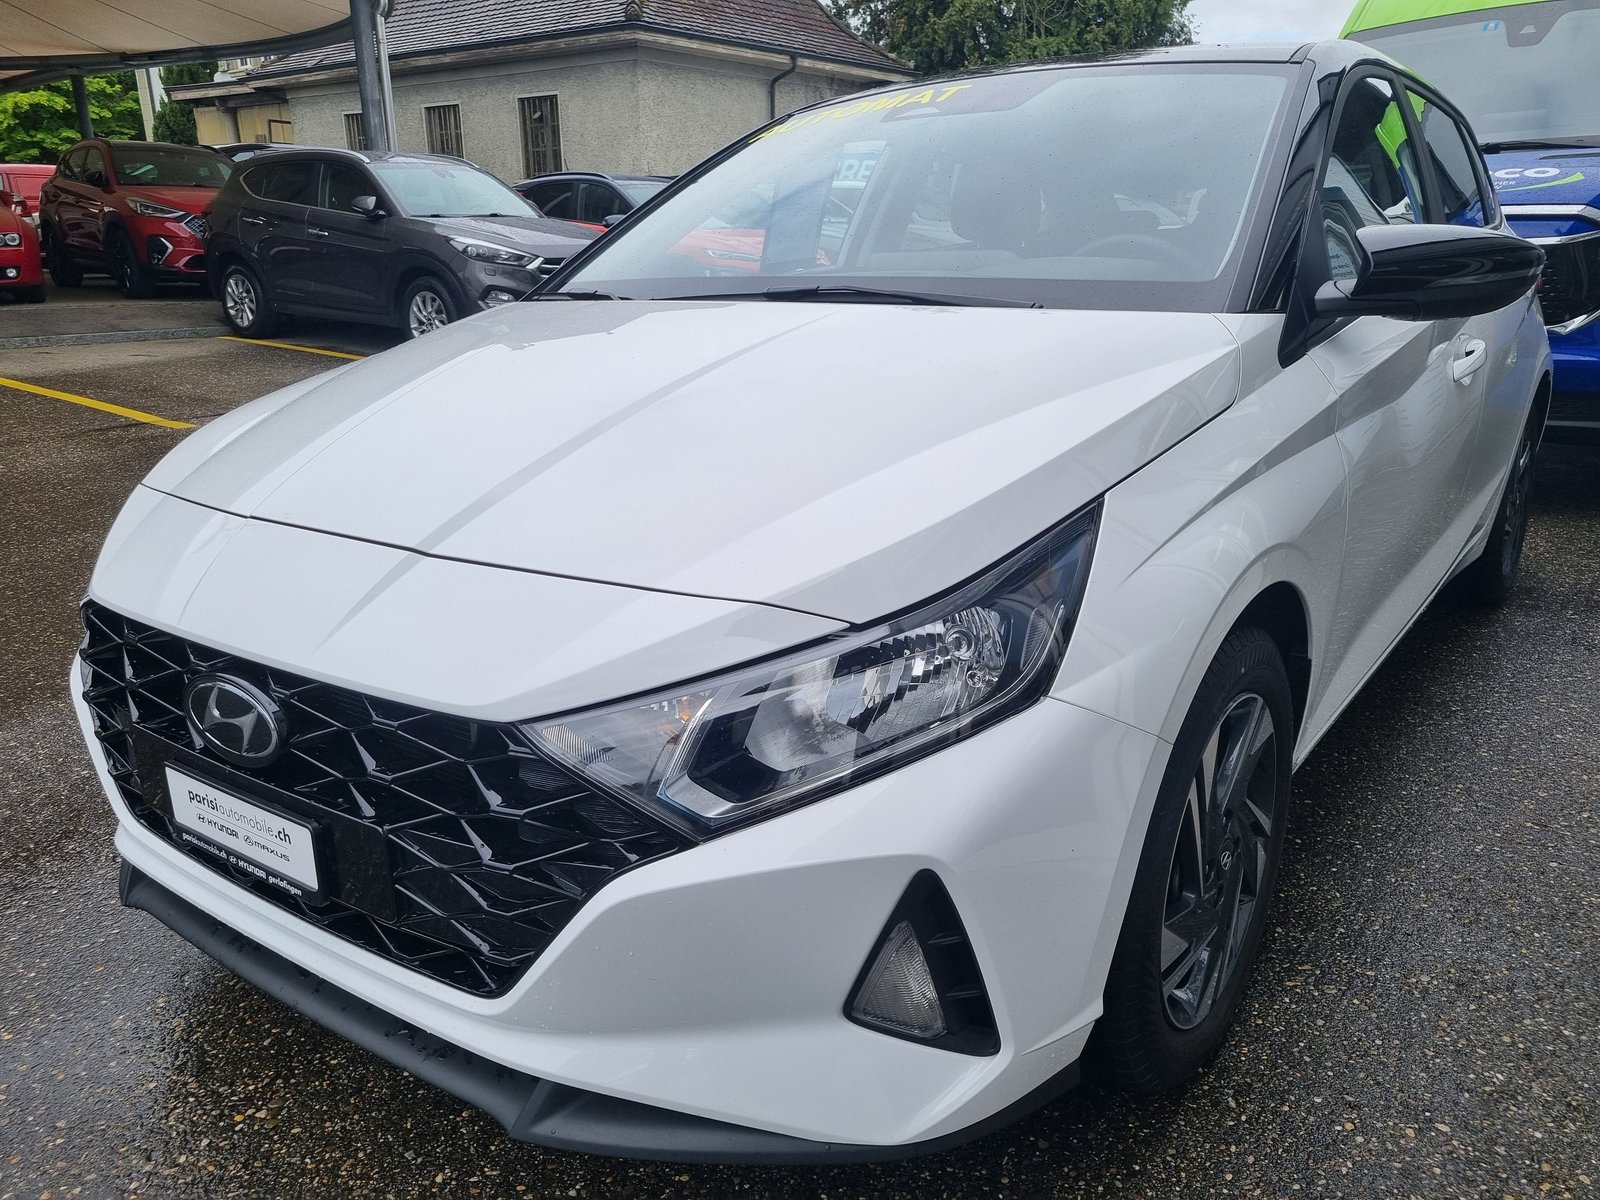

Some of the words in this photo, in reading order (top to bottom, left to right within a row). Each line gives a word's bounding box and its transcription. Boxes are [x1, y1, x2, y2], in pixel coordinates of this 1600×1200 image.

[748, 84, 973, 143] AUTOMAT
[833, 159, 878, 180] RE
[1489, 167, 1560, 178] CO
[188, 789, 292, 845] parisiautomobile.ch
[207, 818, 240, 840] HYUNDAI
[254, 840, 290, 862] MAXUS
[238, 859, 267, 880] HYUNDAI
